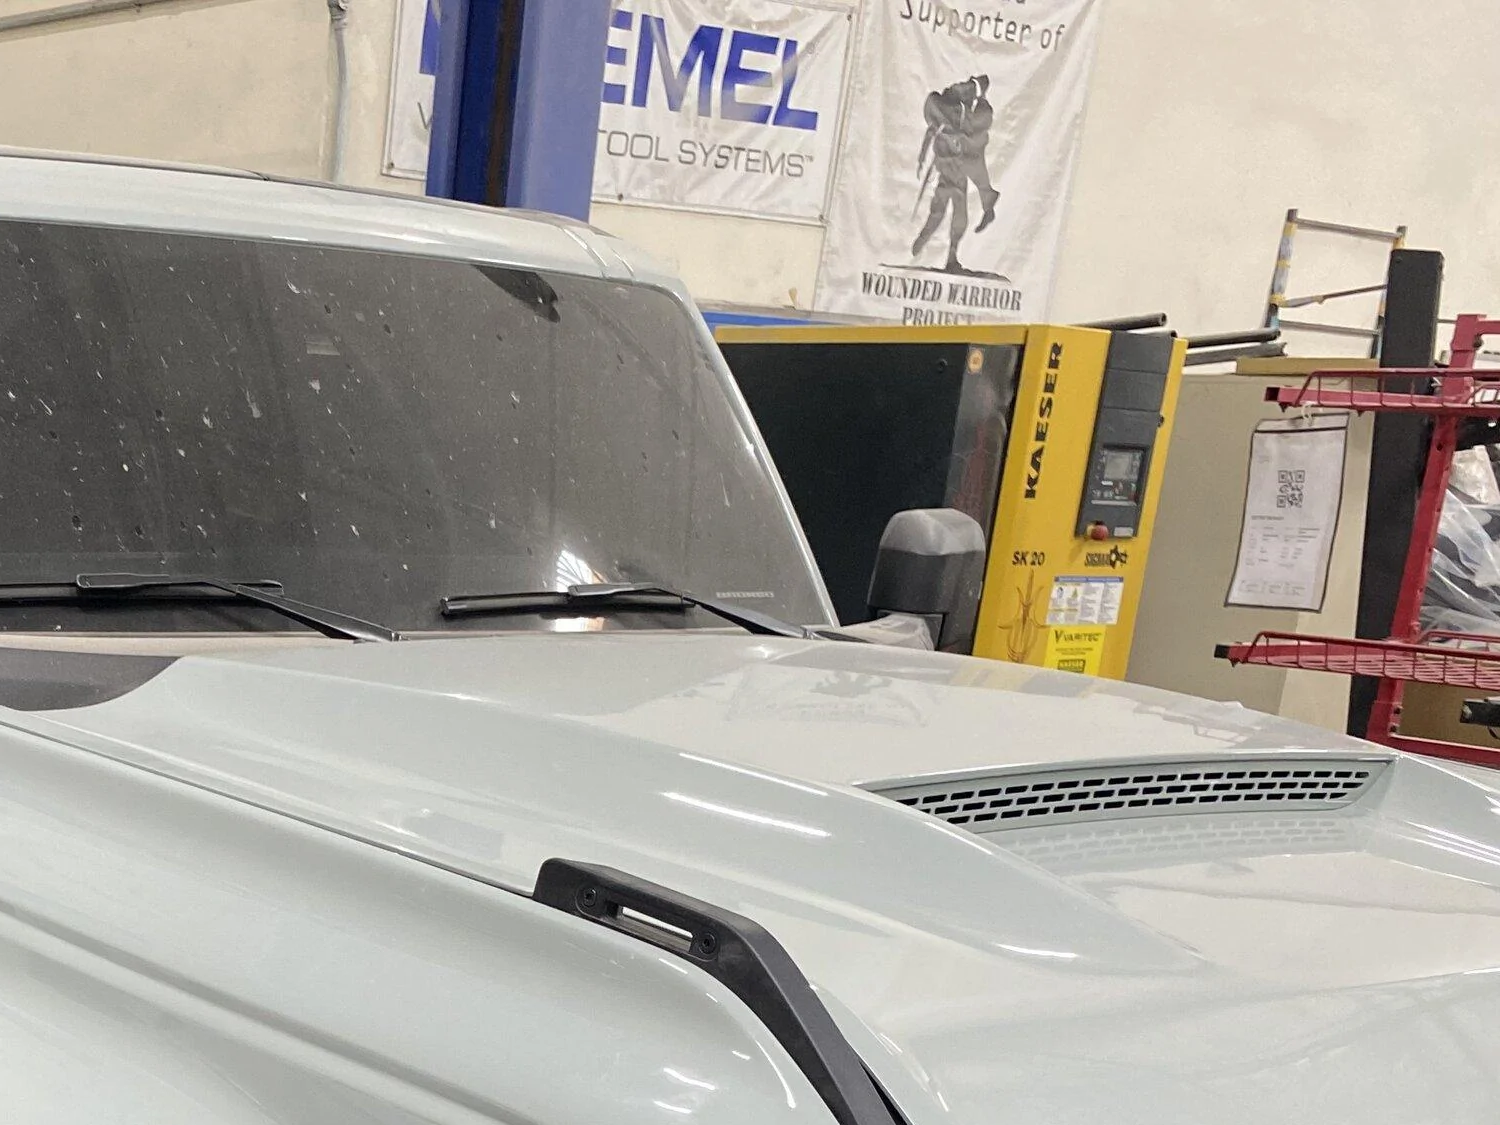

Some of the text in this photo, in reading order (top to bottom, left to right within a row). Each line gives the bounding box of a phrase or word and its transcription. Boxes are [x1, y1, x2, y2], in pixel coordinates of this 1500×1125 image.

[900, 0, 1065, 51] Supporter of
[603, 10, 818, 131] EMEL
[599, 129, 671, 163] OOL
[862, 271, 1022, 312] WOUNDED WARRIOR
[902, 306, 976, 326] PROJECT
[1024, 342, 1062, 499] KAESER
[1012, 550, 1045, 566] SK 20
